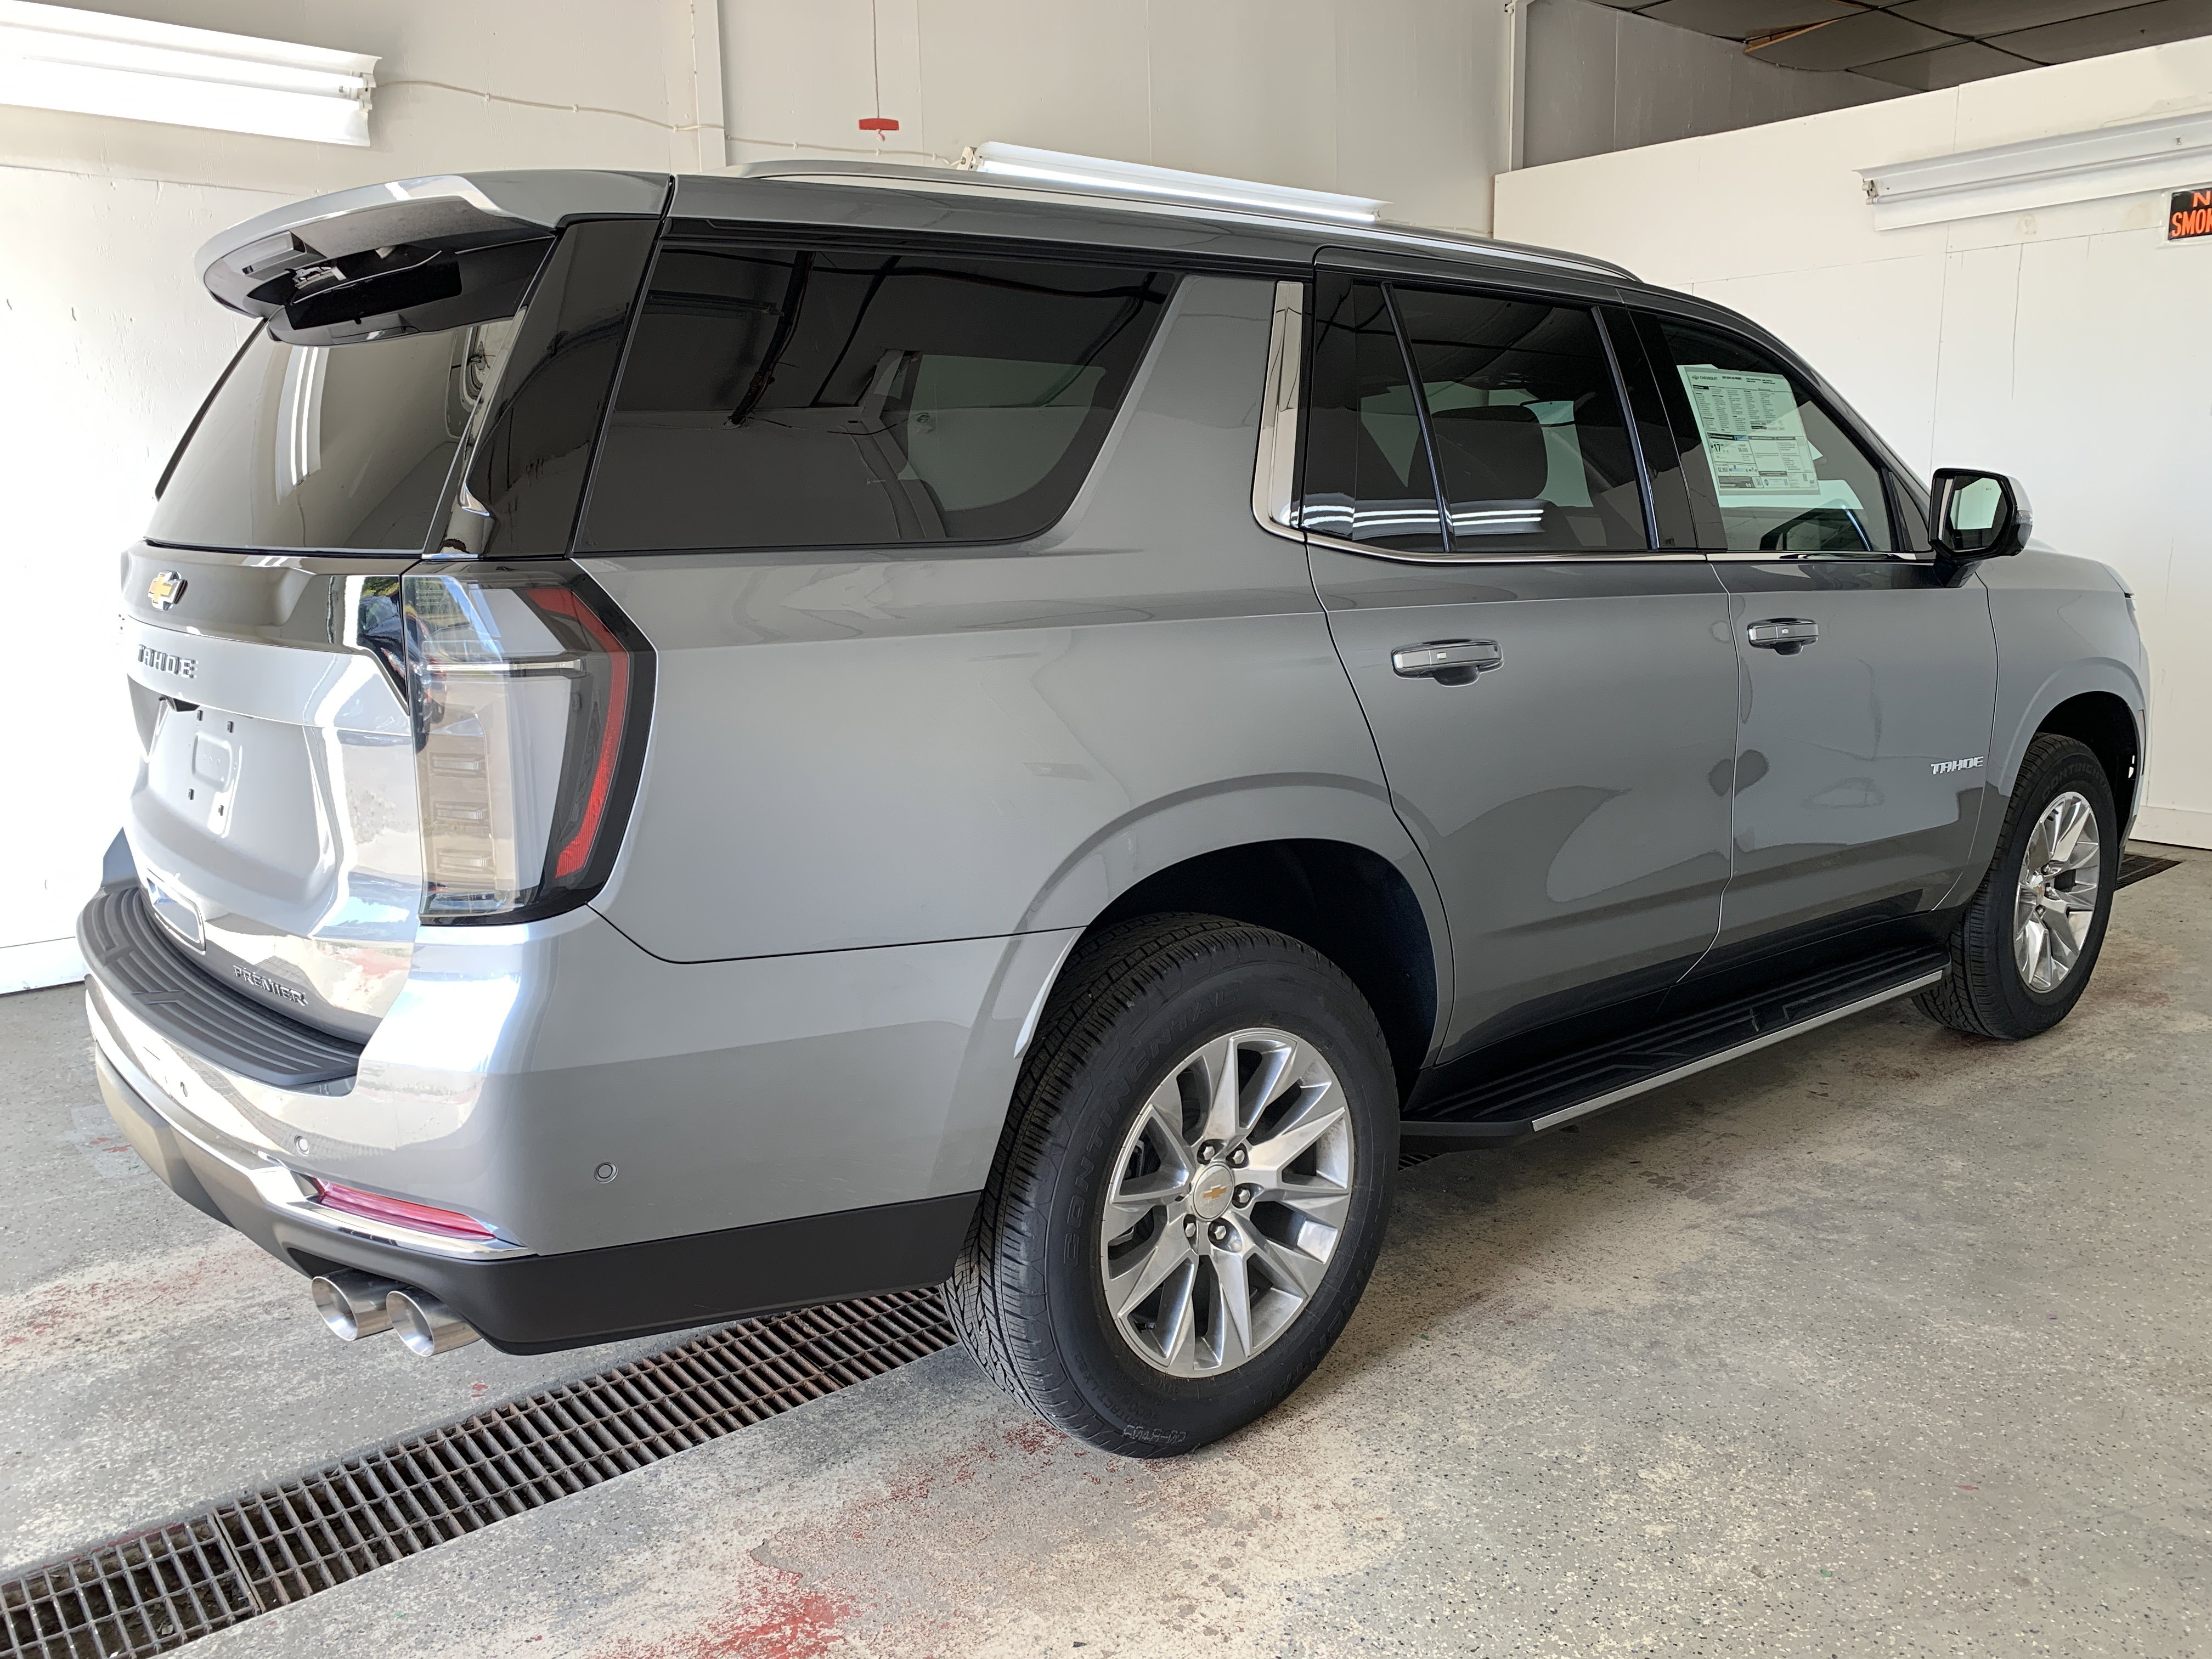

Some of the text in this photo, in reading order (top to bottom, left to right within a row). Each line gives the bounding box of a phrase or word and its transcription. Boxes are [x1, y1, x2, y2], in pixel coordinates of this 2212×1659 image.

[1713, 443, 1721, 453] 17
[138, 644, 199, 679] TAHOE
[1931, 757, 1984, 775] TAHOE
[233, 964, 308, 1007] PREMIER
